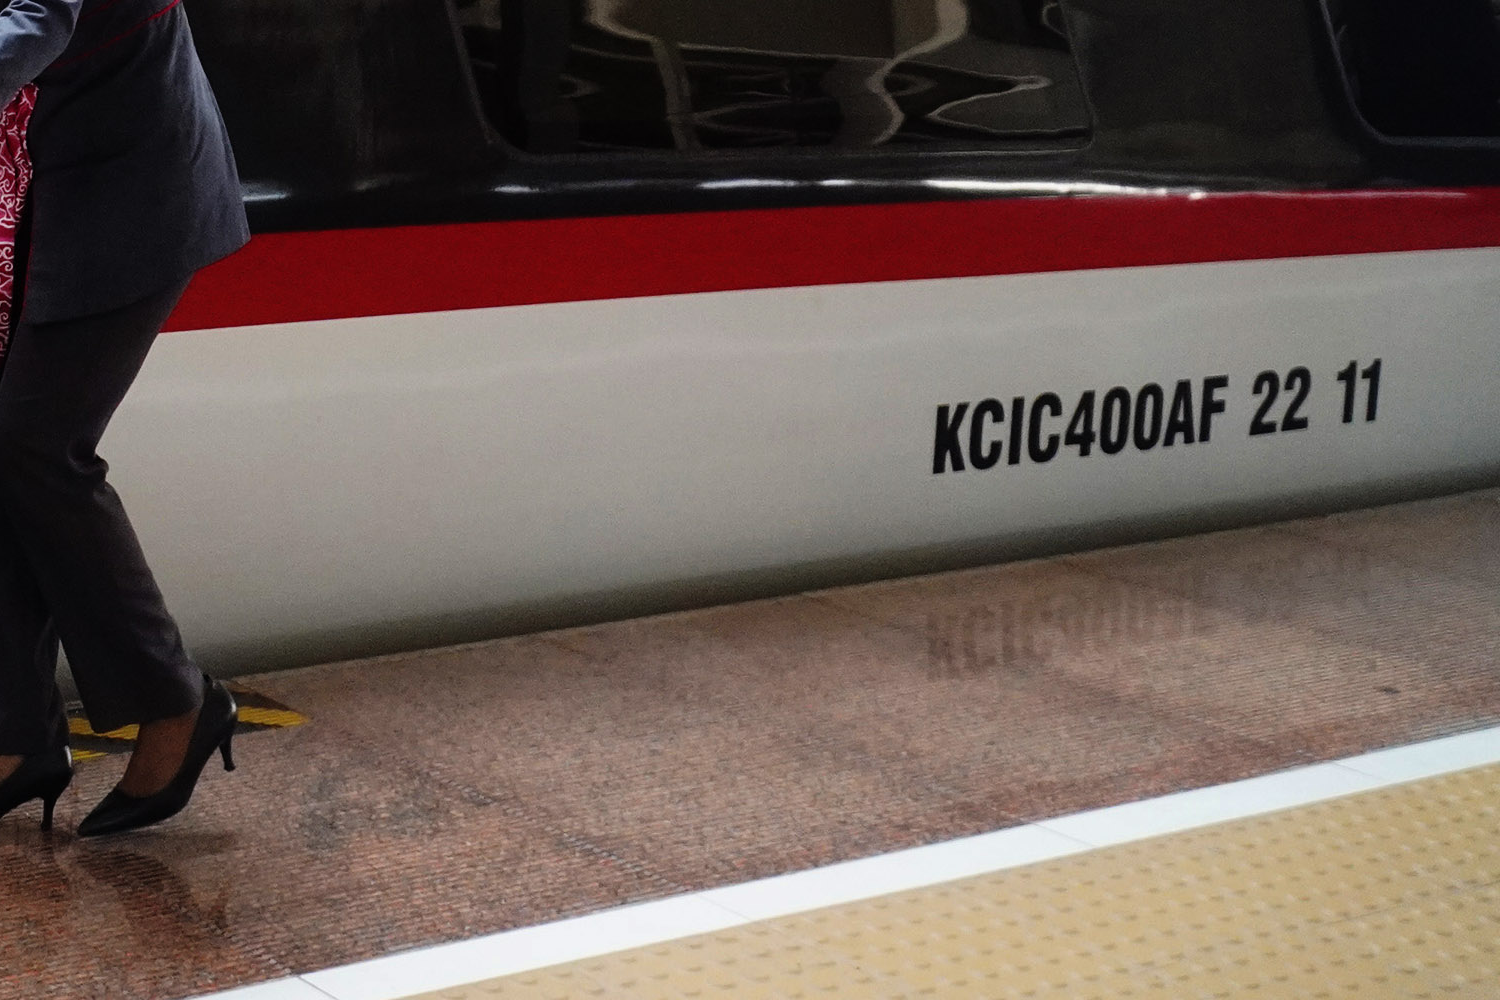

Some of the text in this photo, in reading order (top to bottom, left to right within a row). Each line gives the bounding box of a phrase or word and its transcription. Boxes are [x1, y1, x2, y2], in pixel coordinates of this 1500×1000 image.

[932, 357, 1383, 474] KCIC400AF 22 11
